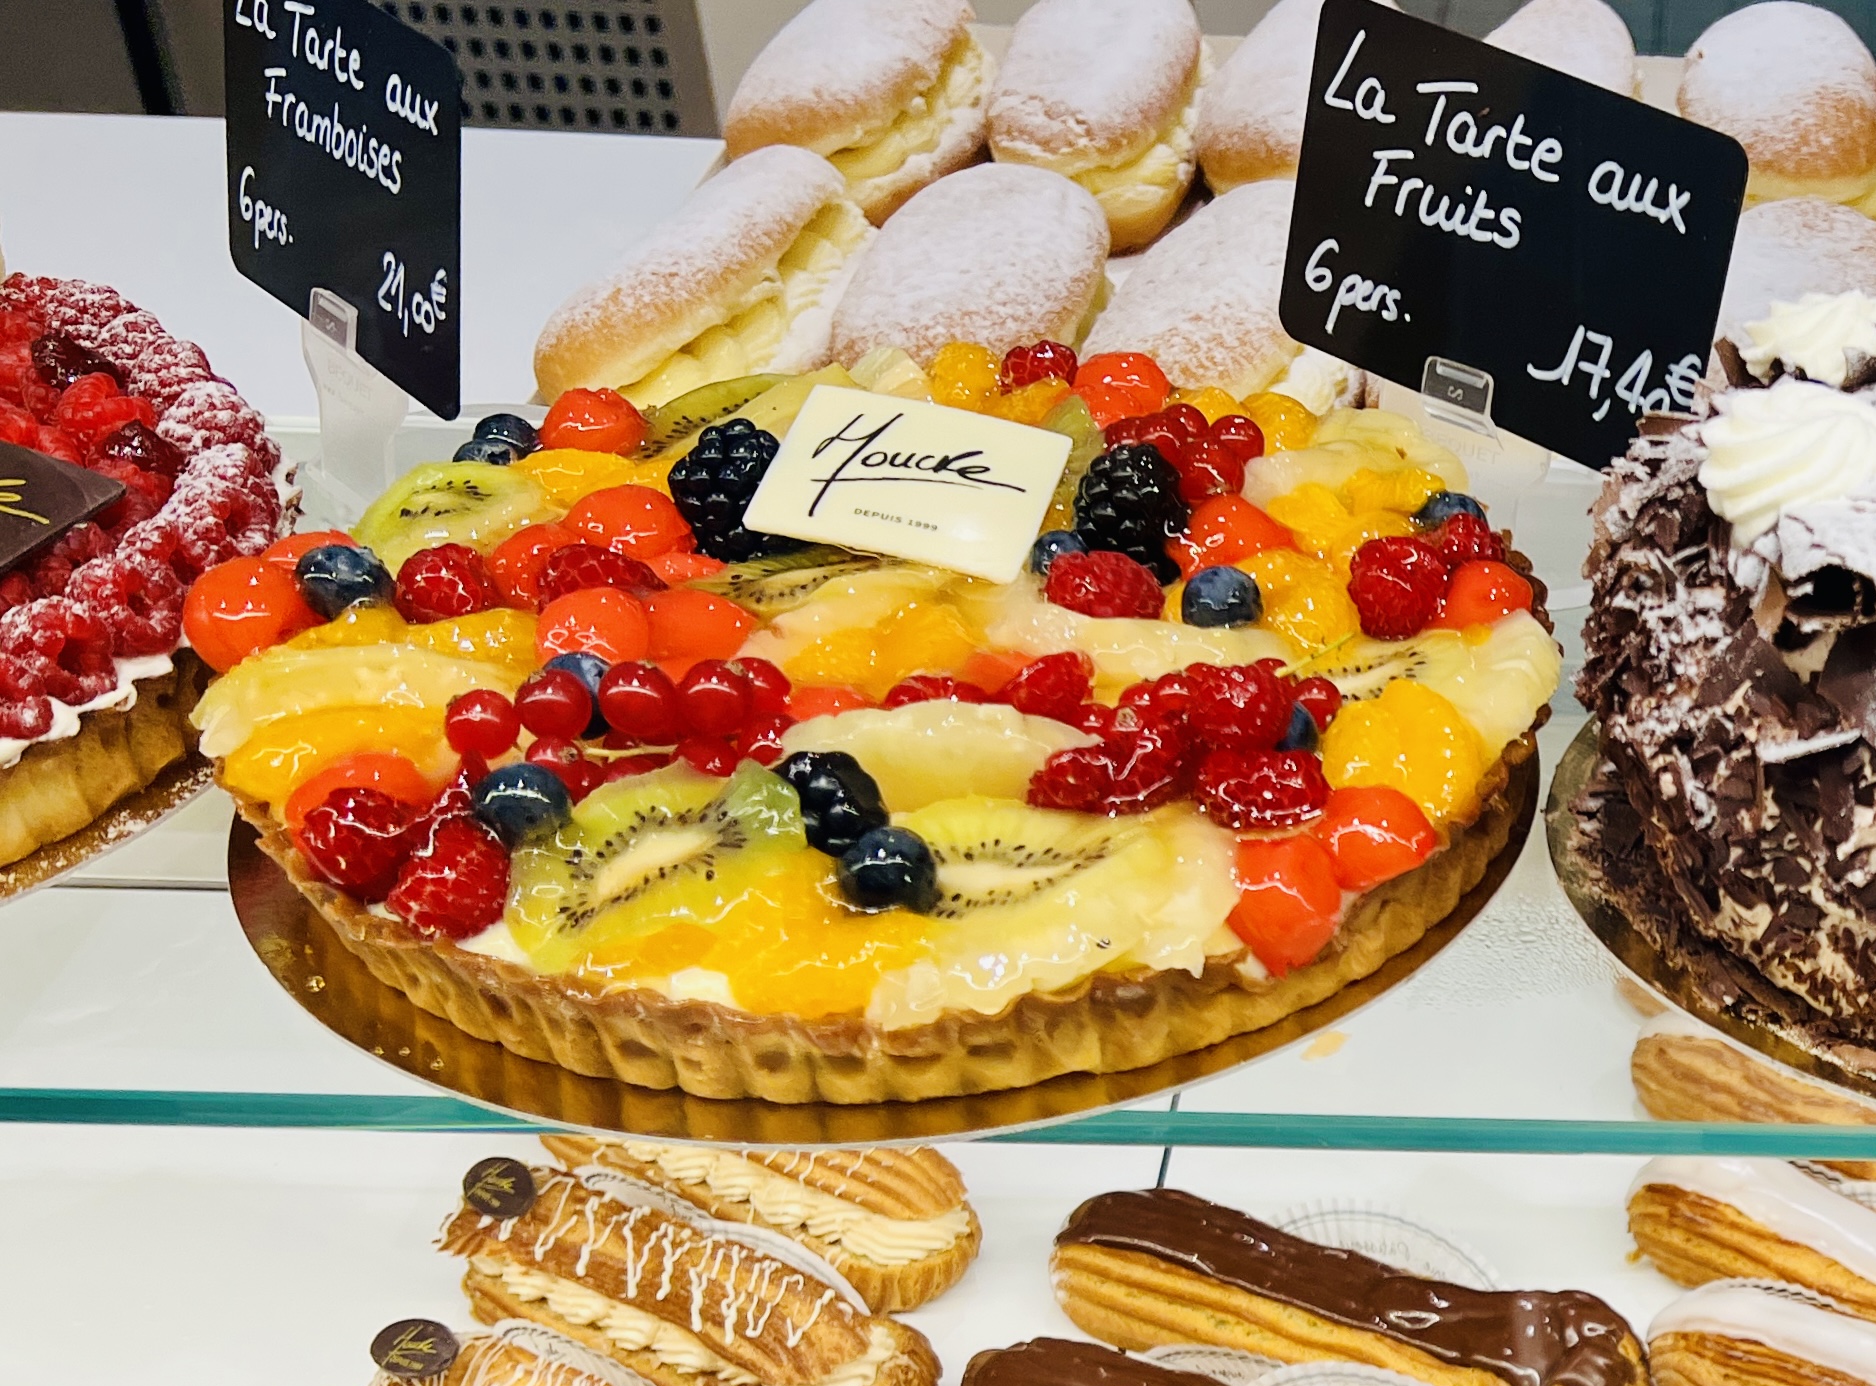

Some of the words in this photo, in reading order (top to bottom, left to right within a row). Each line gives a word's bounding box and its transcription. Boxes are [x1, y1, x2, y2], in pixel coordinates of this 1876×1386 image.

[235, 0, 276, 39] La
[283, 0, 364, 90] Tarte
[385, 73, 439, 136] aux
[264, 67, 402, 195] Framboises
[1324, 29, 1396, 123] La
[1416, 81, 1563, 182] Tarte
[1588, 160, 1691, 235] aux
[1364, 149, 1522, 249] Fruits
[378, 251, 447, 337] 21,00€
[853, 508, 902, 524] DEPUIS
[907, 518, 938, 532] 1999
